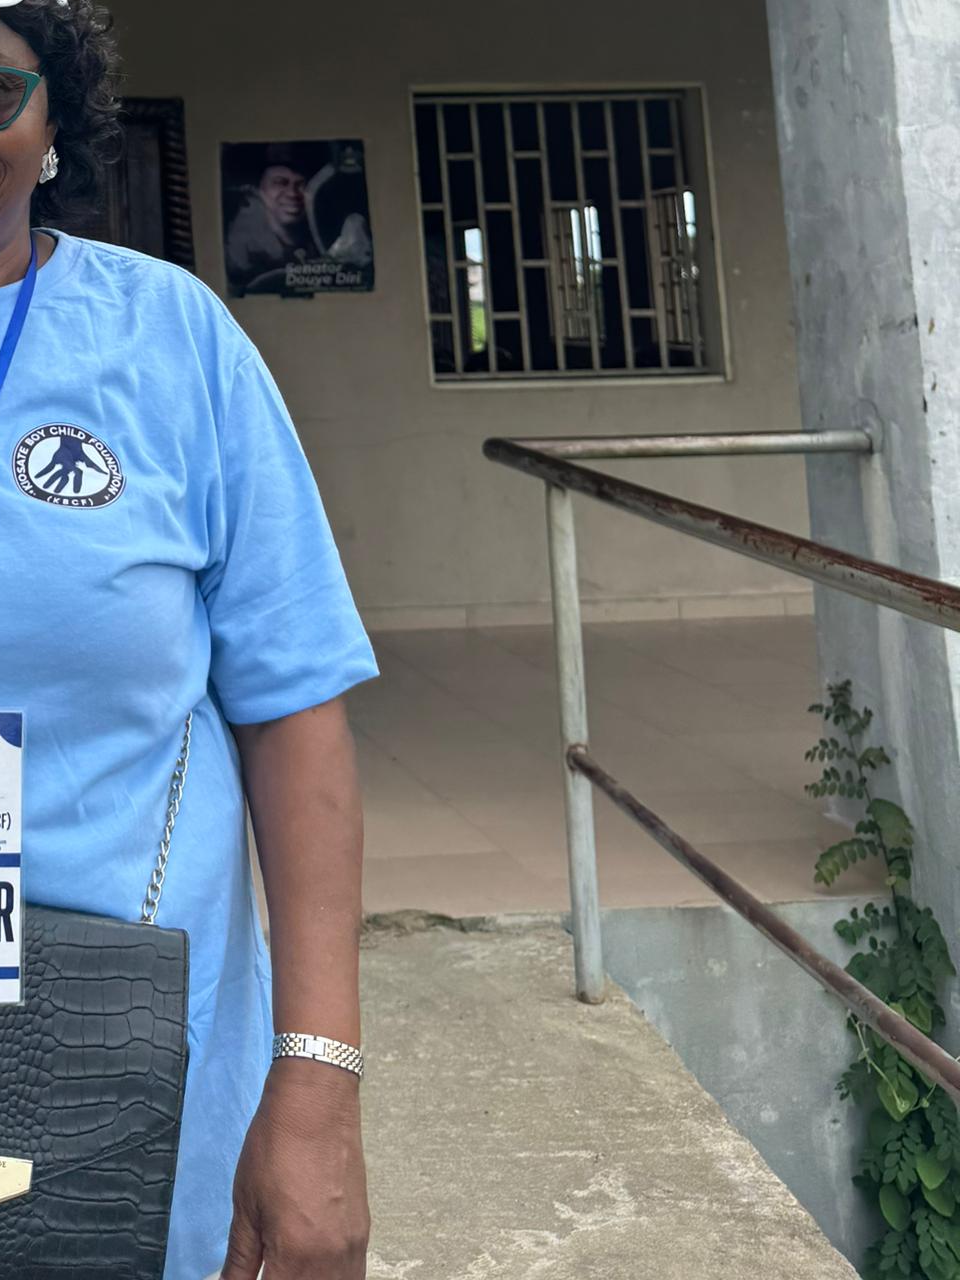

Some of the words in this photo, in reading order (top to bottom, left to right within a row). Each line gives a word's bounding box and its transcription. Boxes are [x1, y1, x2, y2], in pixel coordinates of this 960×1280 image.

[16, 447, 32, 492] KIOSATE
[25, 429, 45, 446] BOY
[50, 426, 86, 439] CHILD
